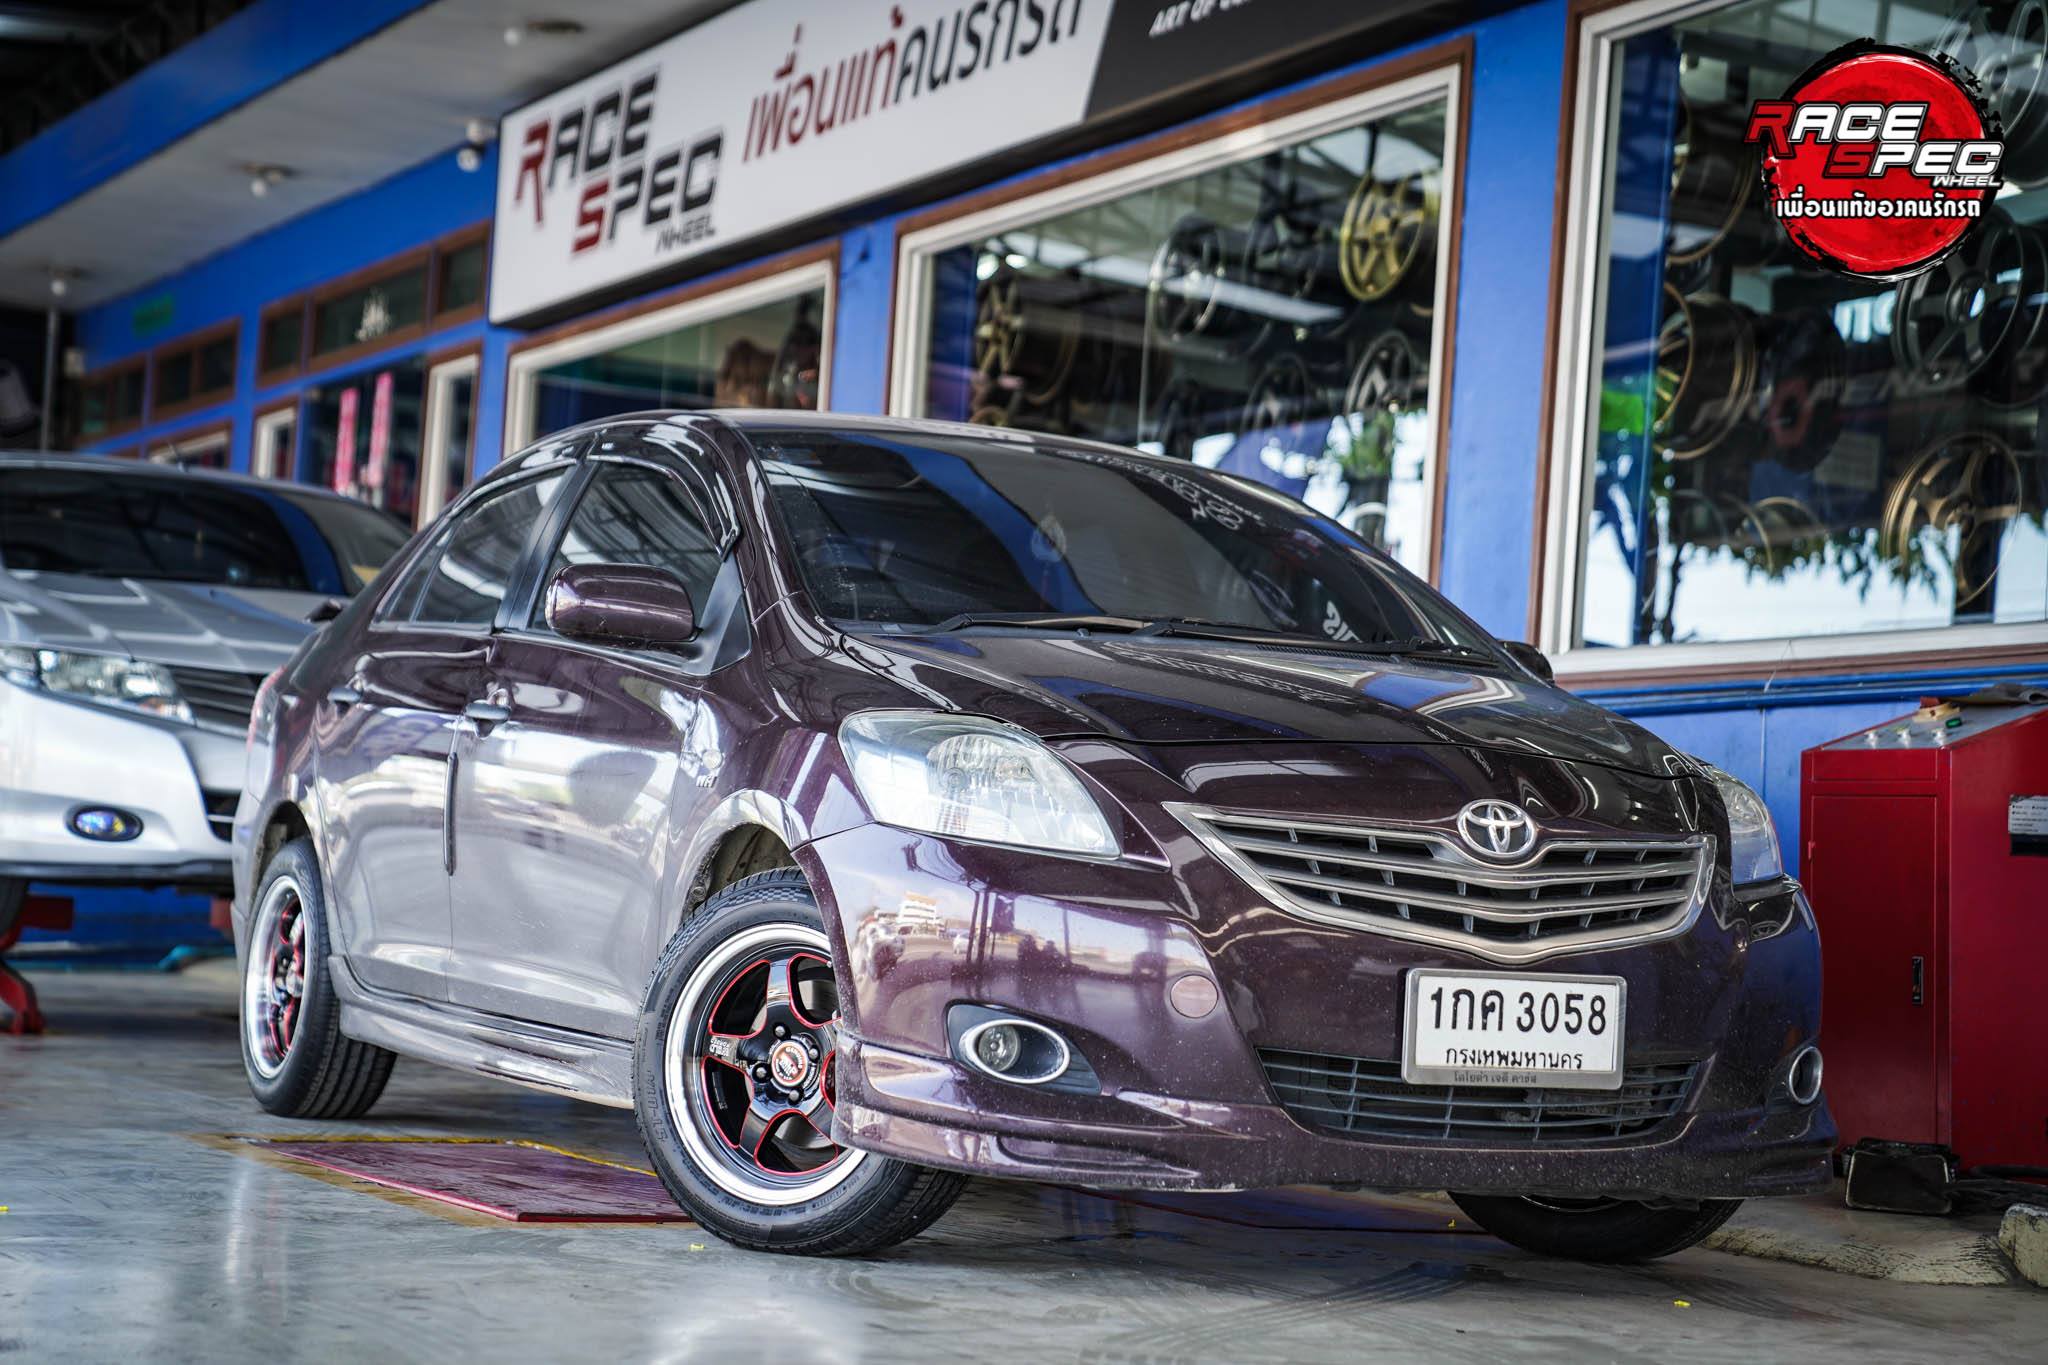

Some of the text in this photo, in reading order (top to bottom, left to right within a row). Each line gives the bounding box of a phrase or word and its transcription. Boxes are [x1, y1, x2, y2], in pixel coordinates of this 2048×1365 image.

[514, 72, 658, 223] RACE
[573, 130, 724, 252] SPEC
[656, 215, 717, 250] WHEEL
[1430, 987, 1606, 1035] 1กค 3058
